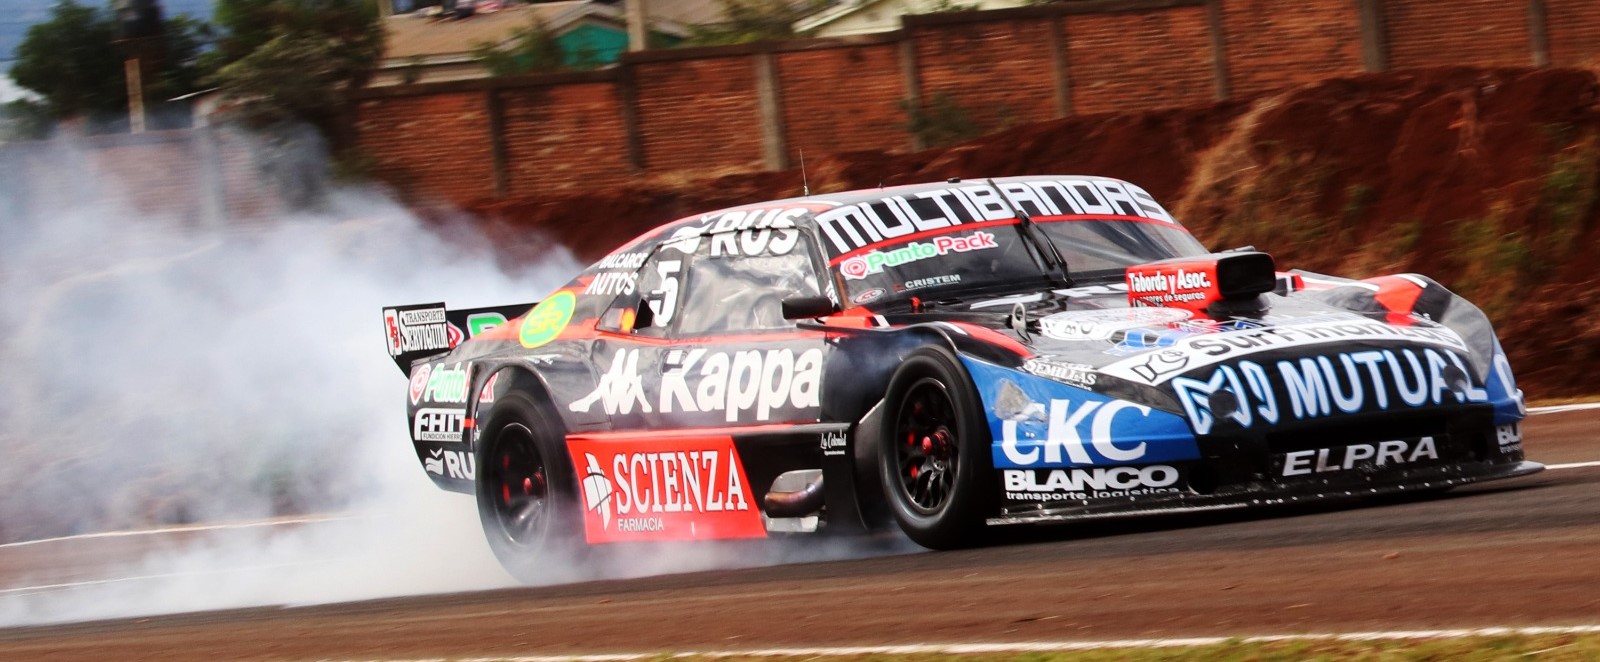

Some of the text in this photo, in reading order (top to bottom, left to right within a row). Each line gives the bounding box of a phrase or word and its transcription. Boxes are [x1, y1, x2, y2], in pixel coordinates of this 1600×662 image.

[710, 208, 808, 257] RUS
[815, 180, 1171, 254] MULTIBANDAS
[585, 271, 639, 296] AUTOS
[650, 259, 681, 327] 5
[904, 274, 961, 289] CRISTEM
[1128, 268, 1211, 294] Taborda y Asoc.
[405, 310, 445, 324] TRANSPORTE
[659, 348, 823, 422] Kappa
[1277, 348, 1488, 420] MUTUAL
[1001, 397, 1152, 466] CKC
[1003, 464, 1180, 493] BLANCO
[1282, 436, 1439, 477] ELPRA
[613, 447, 749, 515] SCIENZA
[617, 518, 664, 532] FARMACIA
